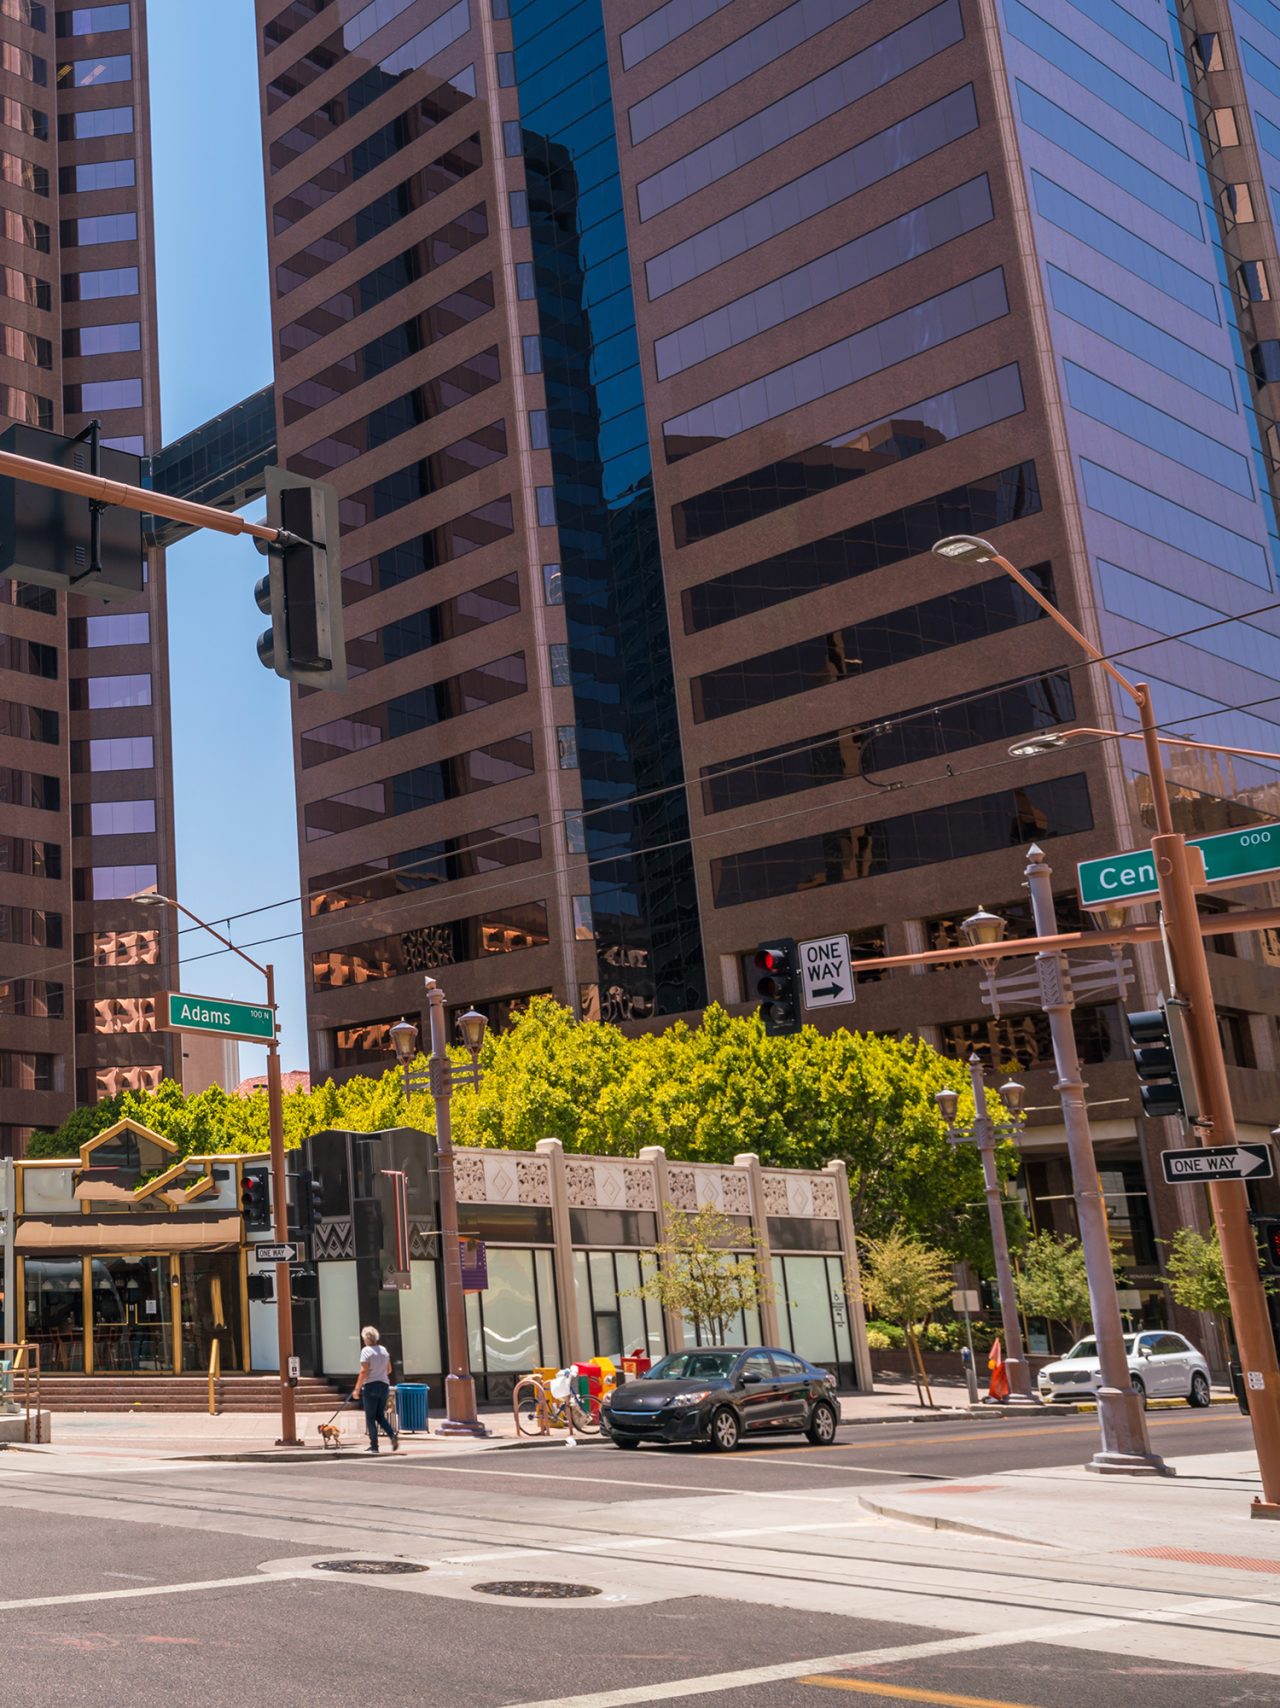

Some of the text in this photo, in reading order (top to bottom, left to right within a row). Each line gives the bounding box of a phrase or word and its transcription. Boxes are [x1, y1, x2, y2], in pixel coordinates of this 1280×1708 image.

[807, 942, 841, 963] ONE
[807, 960, 843, 982] WAY
[180, 1003, 231, 1025] Adams
[250, 1009, 263, 1019] 100
[1174, 1156, 1236, 1173] ONE WAY
[260, 1249, 285, 1257] ONE WAY
